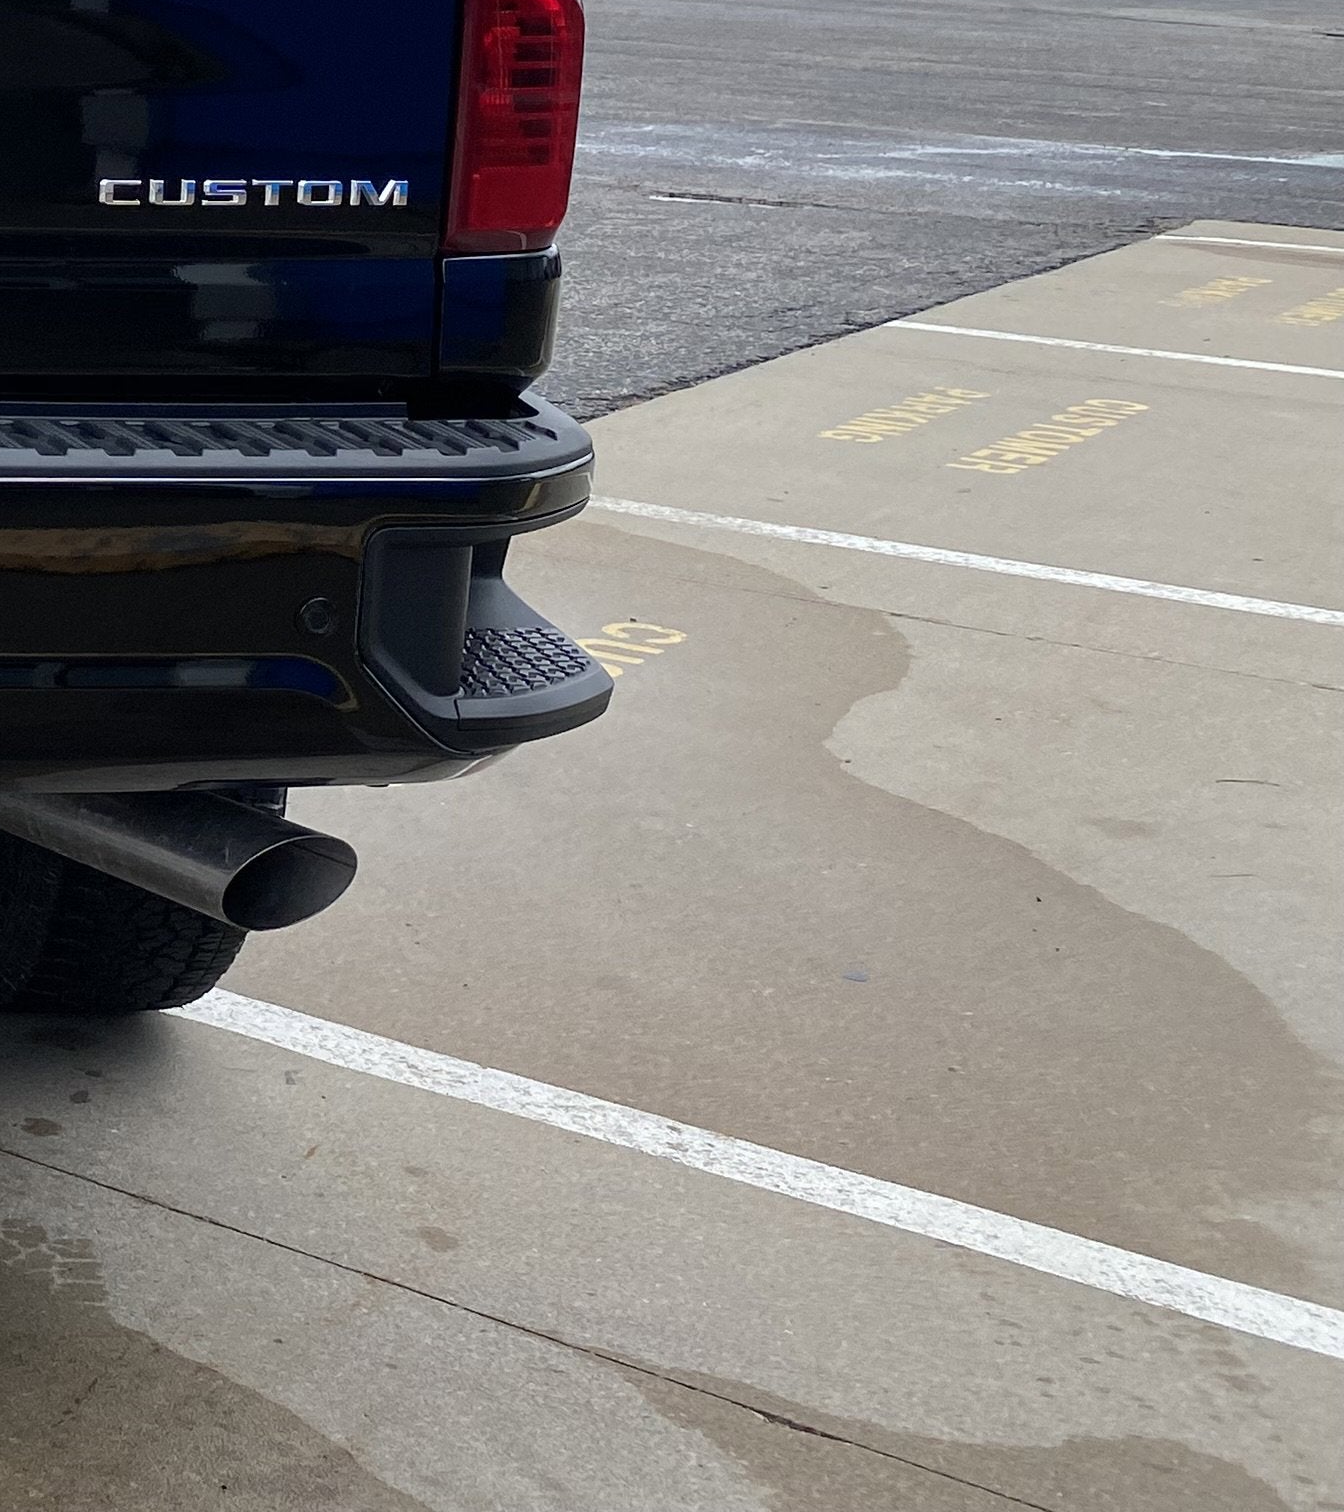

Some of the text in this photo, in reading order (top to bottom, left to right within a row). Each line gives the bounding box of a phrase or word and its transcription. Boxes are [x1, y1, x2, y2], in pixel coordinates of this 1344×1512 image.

[99, 179, 408, 206] CUSTOM
[816, 386, 993, 444] PARKING
[944, 398, 1150, 475] CUSTOMER
[576, 623, 688, 678] CU
